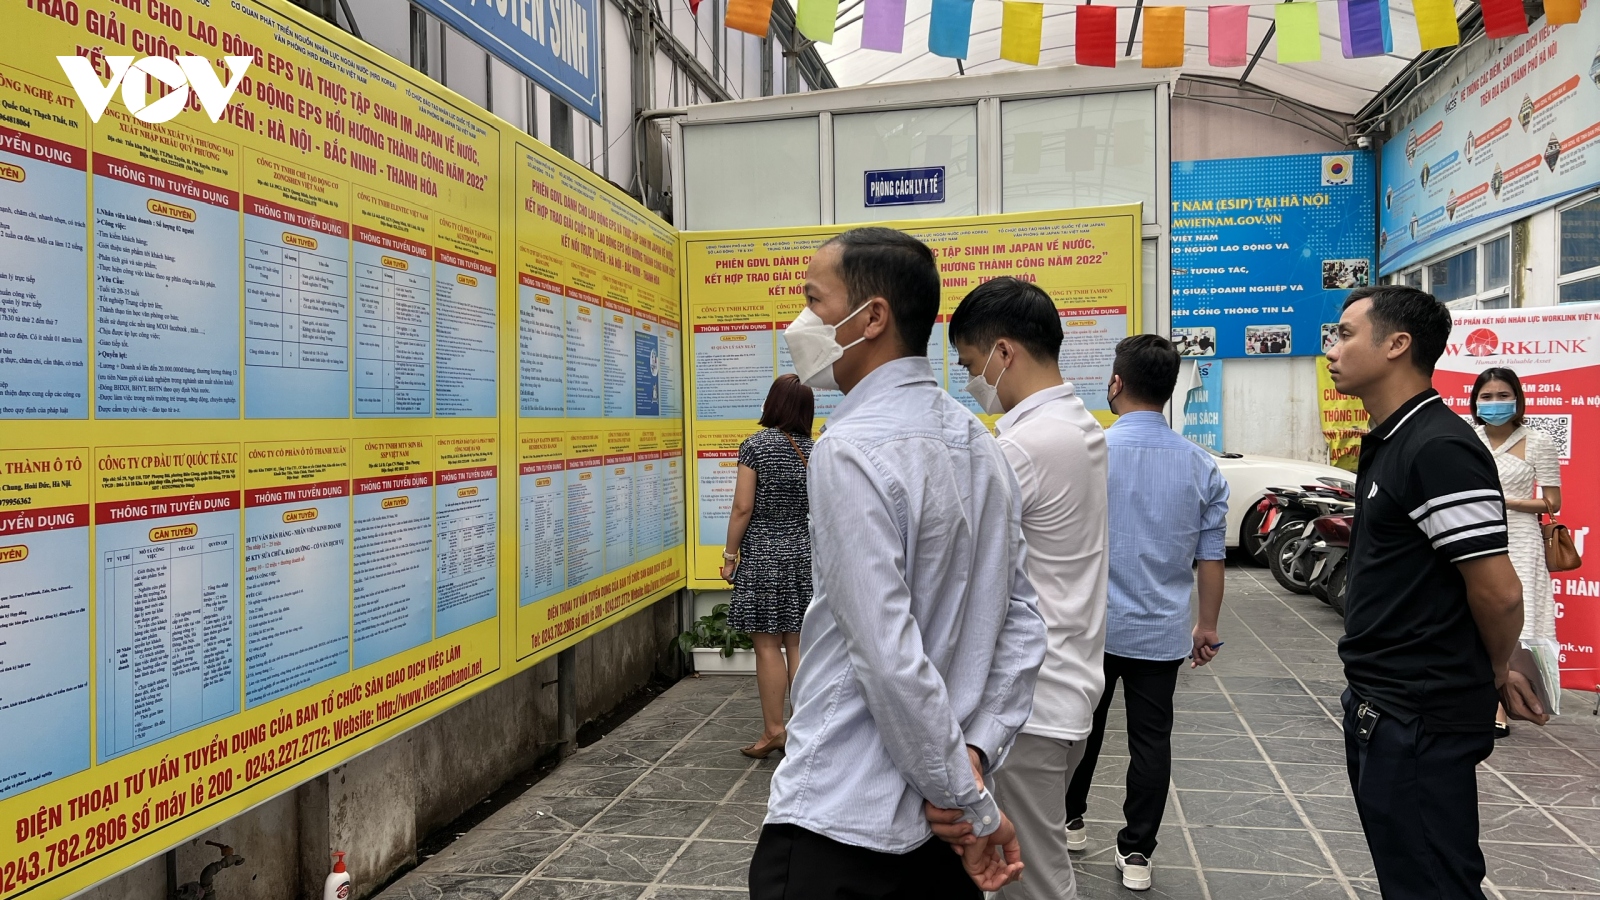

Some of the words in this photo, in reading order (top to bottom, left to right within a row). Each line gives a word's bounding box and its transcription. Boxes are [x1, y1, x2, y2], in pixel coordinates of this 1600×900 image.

[86, 10, 125, 44] GIẢI
[549, 0, 588, 79] SINH
[147, 0, 182, 30] CHO
[188, 16, 217, 46] LAO
[267, 53, 293, 80] EPS
[297, 66, 313, 90] VÀ
[317, 76, 346, 104] THỰC
[350, 91, 370, 115] TẬP
[373, 103, 397, 127] SINH
[400, 115, 411, 134] IM
[414, 123, 442, 147] JAPAN
[444, 135, 454, 153] VỀ
[24, 84, 53, 103] NGHỆ
[55, 95, 74, 108] ATT
[256, 81, 293, 113] ĐỘNG
[298, 99, 321, 124] EPS
[325, 110, 344, 134] HỒI
[348, 120, 383, 149] HƯƠNG
[387, 137, 417, 162] THÀNH
[420, 151, 443, 173] CÔNG
[446, 162, 464, 182] NĂM
[267, 118, 285, 142] HÀ
[289, 128, 311, 153] NỘI
[324, 138, 346, 164] BẮC
[350, 151, 376, 174] NINH
[386, 164, 417, 189] THANH
[420, 177, 437, 197] HÓA
[108, 163, 144, 182] THÔNG
[148, 174, 164, 187] TIN
[168, 180, 199, 196] TUYỂN
[202, 189, 228, 204] DỤNG
[870, 178, 893, 196] PHÒNG
[895, 177, 913, 195] CÁCH
[914, 178, 922, 194] LY
[923, 178, 928, 193] Y
[929, 173, 937, 193] TẾ
[1182, 199, 1213, 211] NAM
[1215, 198, 1252, 211] (ESIP)
[1255, 196, 1276, 210] TẠI
[1302, 193, 1328, 207] NỘI
[942, 246, 960, 258] TẬP
[964, 245, 989, 255] SINH
[992, 244, 1005, 253] IM
[1009, 242, 1042, 252] JAPAN
[1046, 238, 1058, 250] VỀ
[715, 258, 743, 268] PHIÊN
[746, 258, 770, 267] GDVL
[773, 256, 799, 266] DÀNH
[940, 261, 975, 271] HƯƠNG
[978, 259, 1012, 269] THÀNH
[1015, 257, 1044, 267] CÔNG
[1047, 256, 1072, 266] NĂM
[704, 273, 721, 284] KẾT
[724, 273, 743, 284] HỢP
[746, 272, 769, 282] TRAO
[772, 269, 791, 280] GIẢI
[1538, 384, 1561, 392] 2014
[1537, 395, 1562, 406] HÙNG
[1572, 395, 1584, 406] HÀ
[1199, 410, 1218, 425] SÁCH
[1324, 408, 1351, 422] THÔNG
[1354, 410, 1368, 421] TIN
[5, 458, 49, 473] THÀNH
[53, 457, 62, 471] Ô
[65, 456, 81, 470] TÔ
[98, 454, 125, 470] CÔNG
[127, 457, 139, 468] TY
[141, 456, 152, 468] CP
[172, 453, 185, 466] TƯ
[221, 452, 237, 463] S.T.C
[16, 804, 61, 842] ĐIỆN
[68, 782, 118, 820] THOẠI
[124, 769, 145, 797] TƯ
[148, 754, 178, 787] VẤN
[184, 734, 227, 772] TUYỂN
[232, 724, 265, 753] DỤNG
[269, 708, 292, 737] CỦA
[296, 702, 318, 726] BAN
[321, 689, 333, 715] TỔ
[336, 683, 361, 708] CHỨC
[364, 676, 383, 697] SÀN
[385, 668, 405, 688] GIAO
[407, 659, 425, 680] DỊCH
[427, 651, 443, 670] VIỆC
[445, 644, 460, 663] LÀM
[132, 798, 150, 833] số
[155, 791, 185, 822] máy
[190, 777, 203, 806] lẻ
[208, 768, 232, 798] 200
[333, 710, 373, 740] Website:
